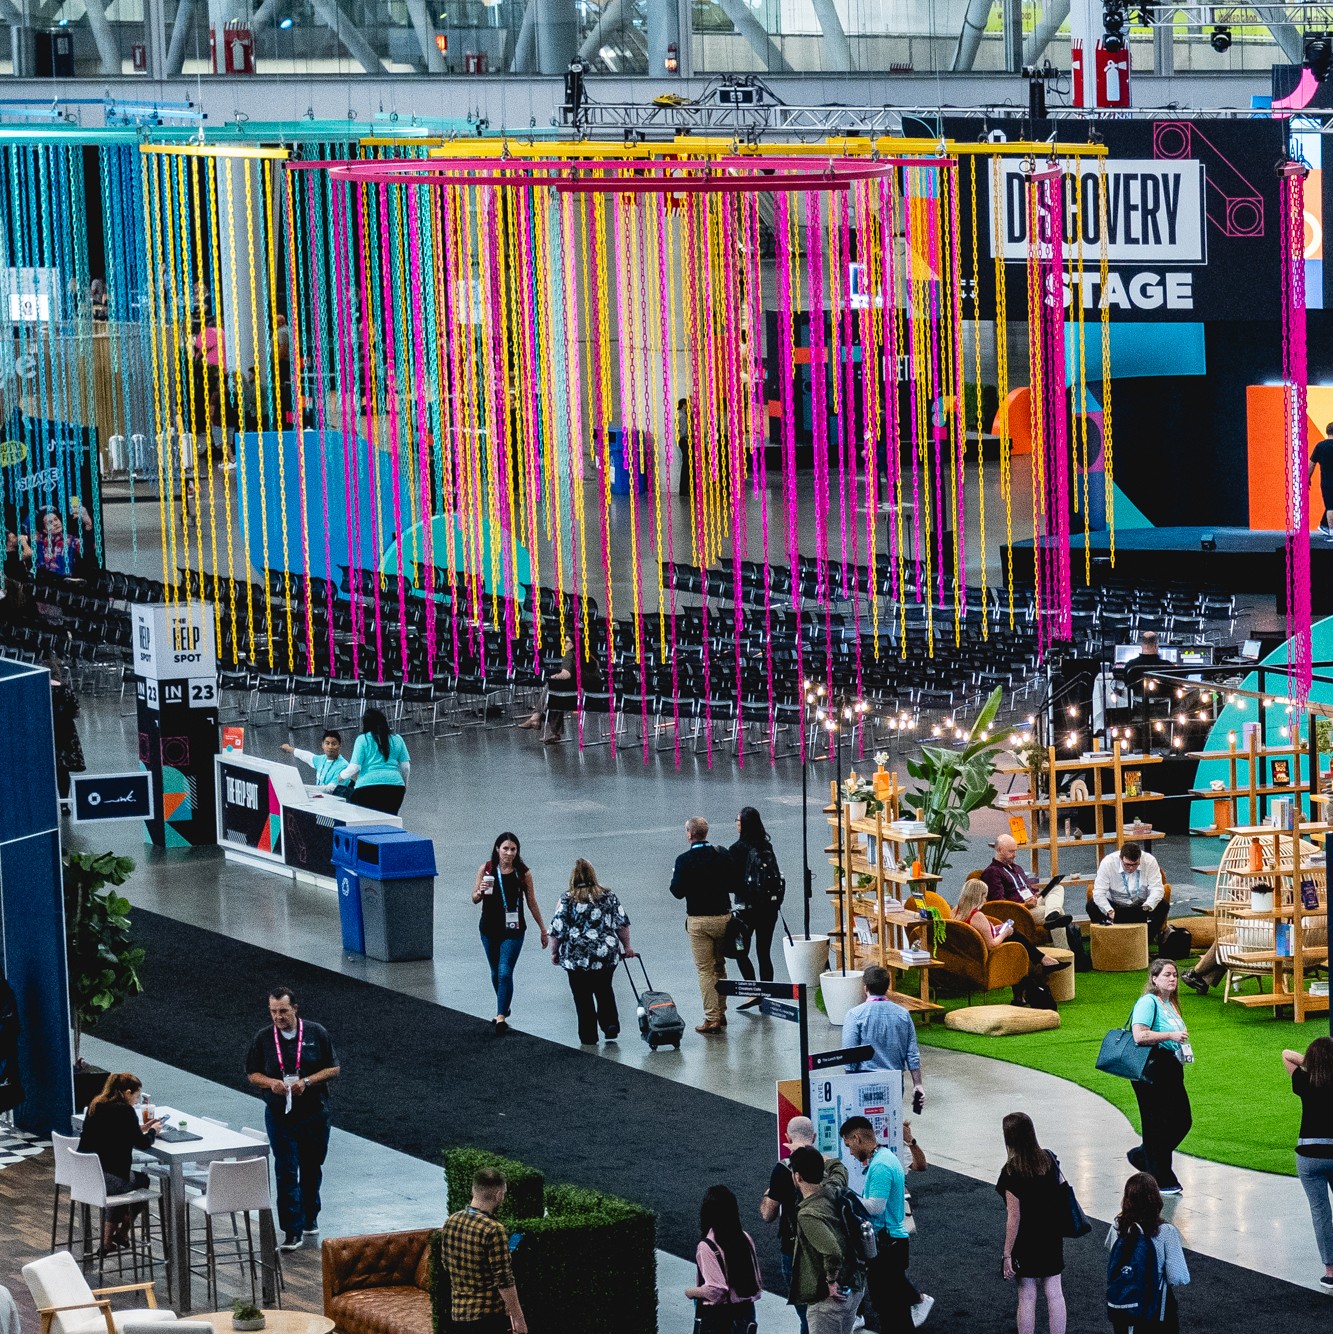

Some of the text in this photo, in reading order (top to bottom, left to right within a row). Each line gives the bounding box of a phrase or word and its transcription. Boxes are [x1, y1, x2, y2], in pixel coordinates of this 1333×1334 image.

[1044, 271, 1194, 310] STAGE
[173, 653, 202, 663] SPOT
[148, 685, 157, 702] 23
[165, 684, 215, 701] IN 23
